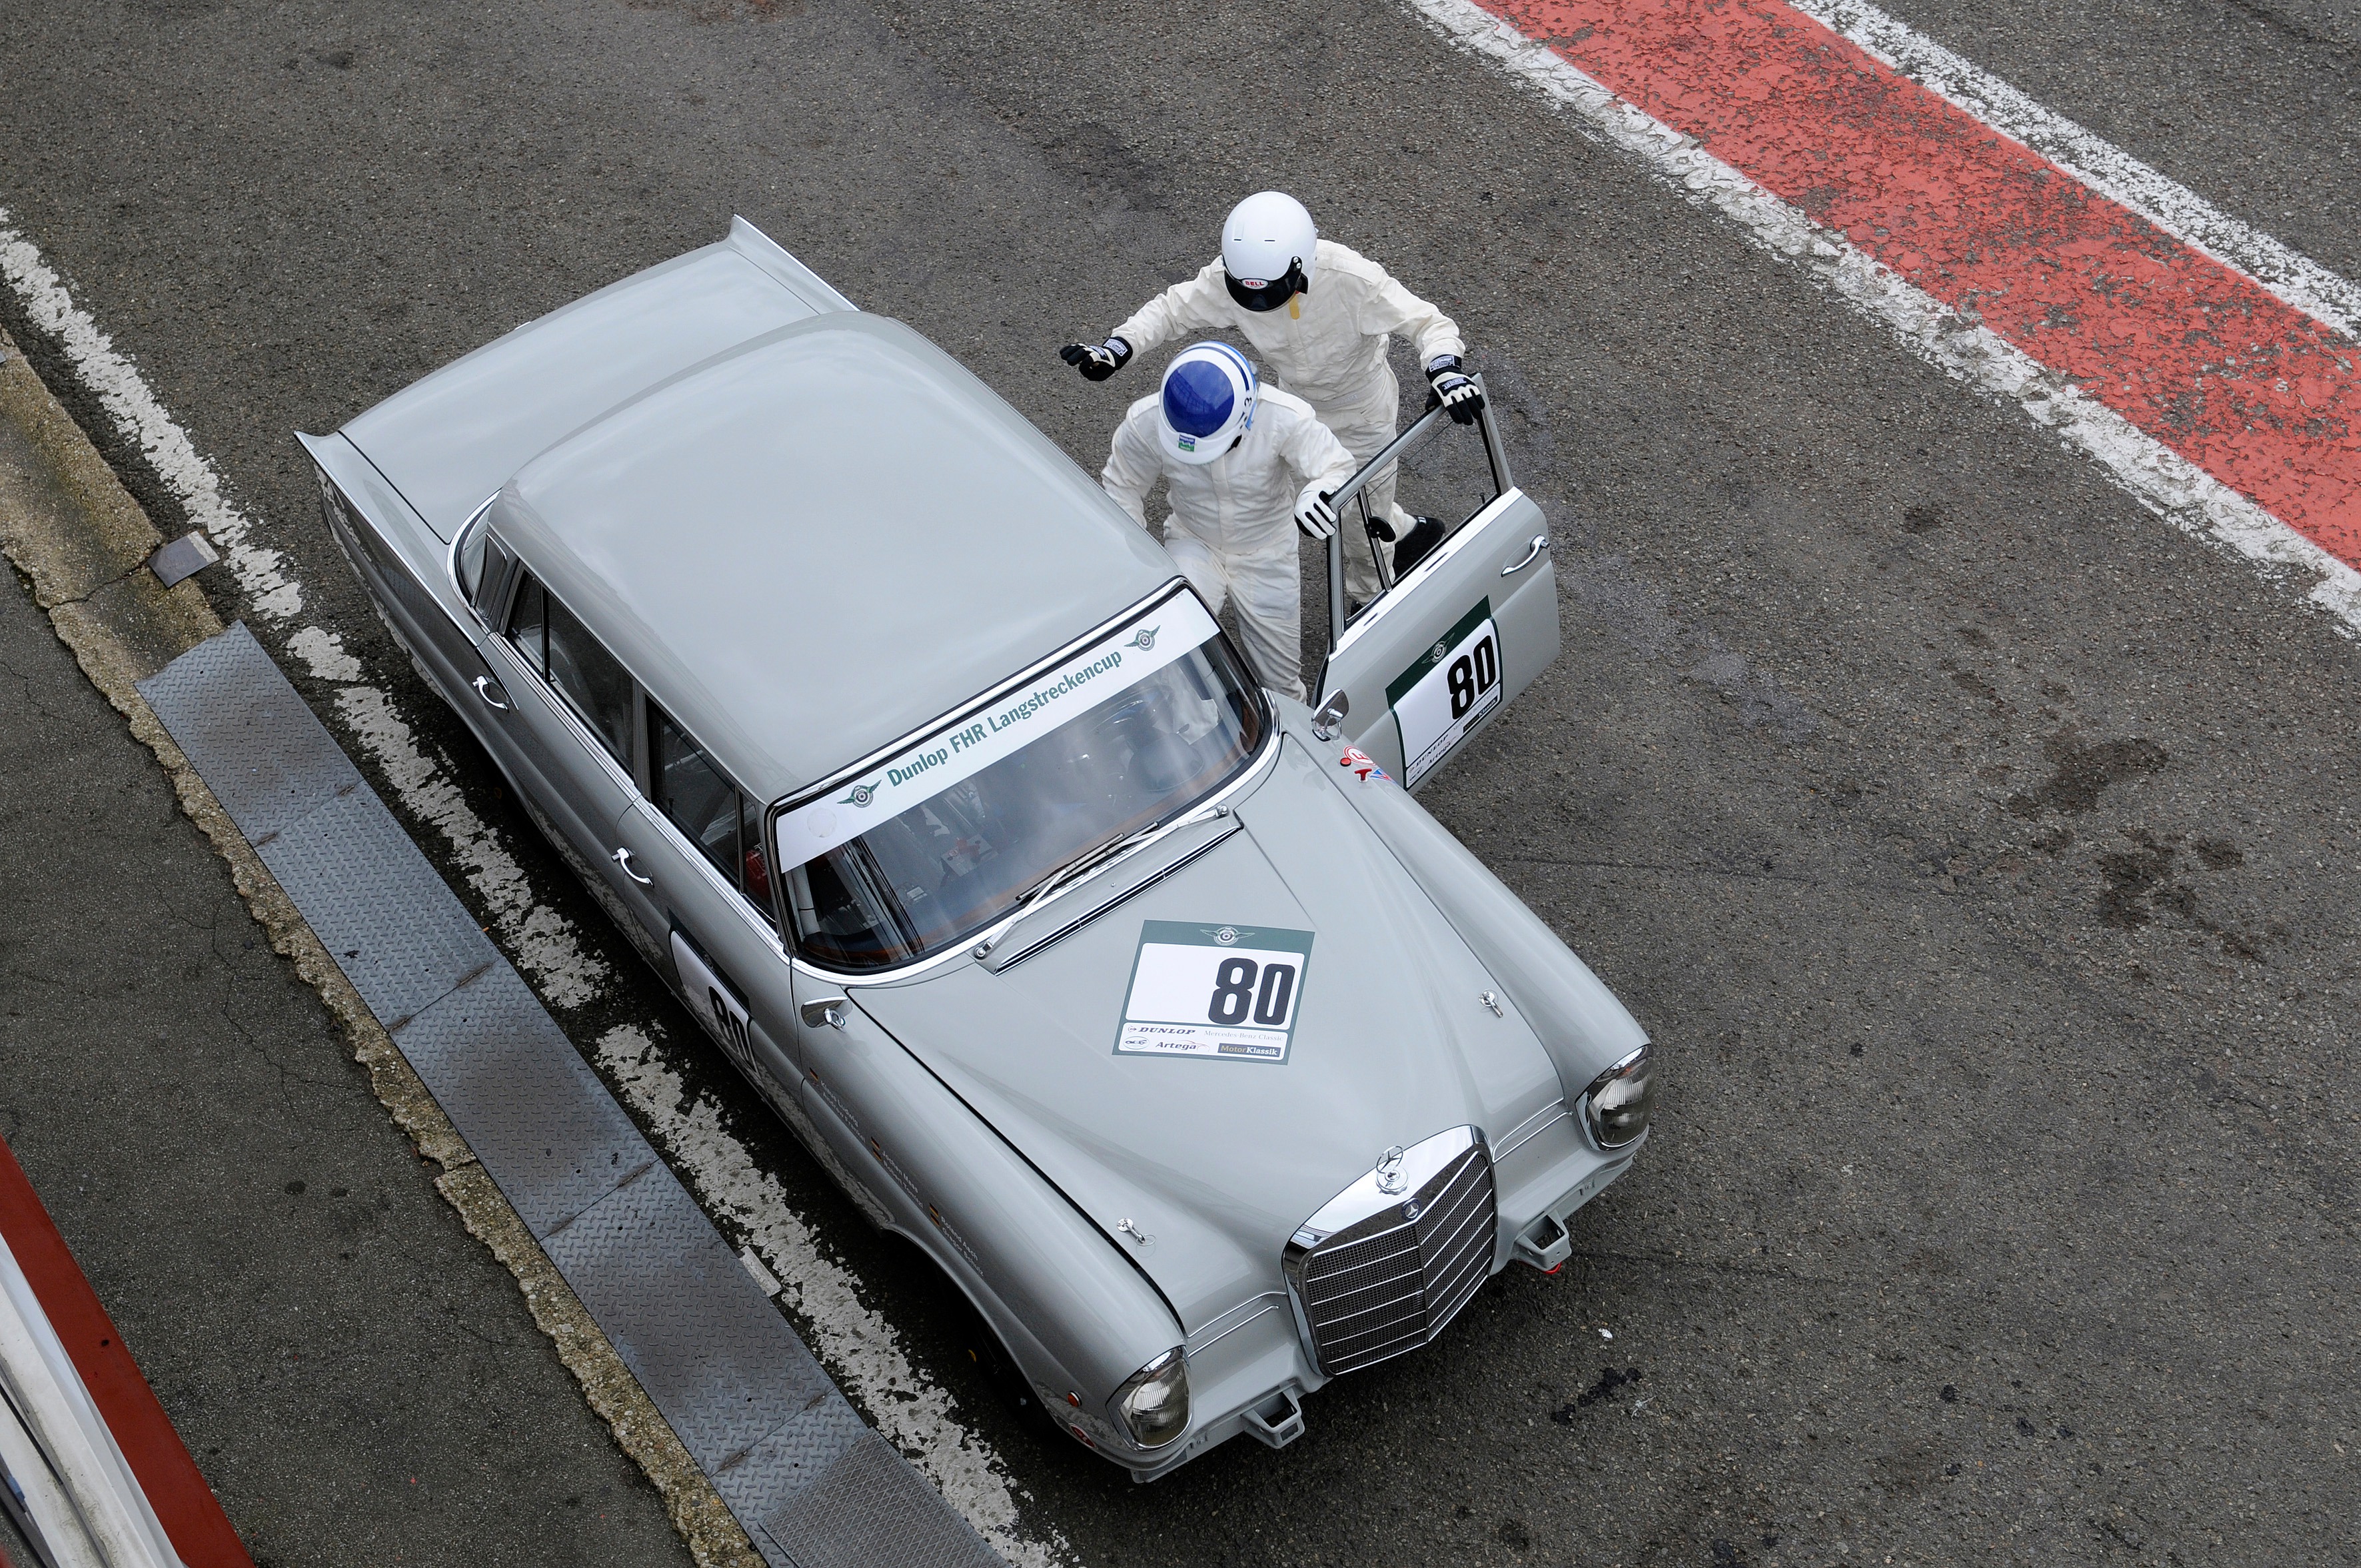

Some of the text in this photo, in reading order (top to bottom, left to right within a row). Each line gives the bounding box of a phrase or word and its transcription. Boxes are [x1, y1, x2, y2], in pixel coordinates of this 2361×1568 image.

[1447, 635, 1497, 720] 80
[886, 651, 1122, 788] Dunlop FHR Langstreckencup
[1208, 957, 1296, 1026] 80
[1155, 1042, 1197, 1051] Artega
[1204, 1030, 1256, 1039] Mercedes-Benz
[1221, 1045, 1278, 1056] MotorKlassik
